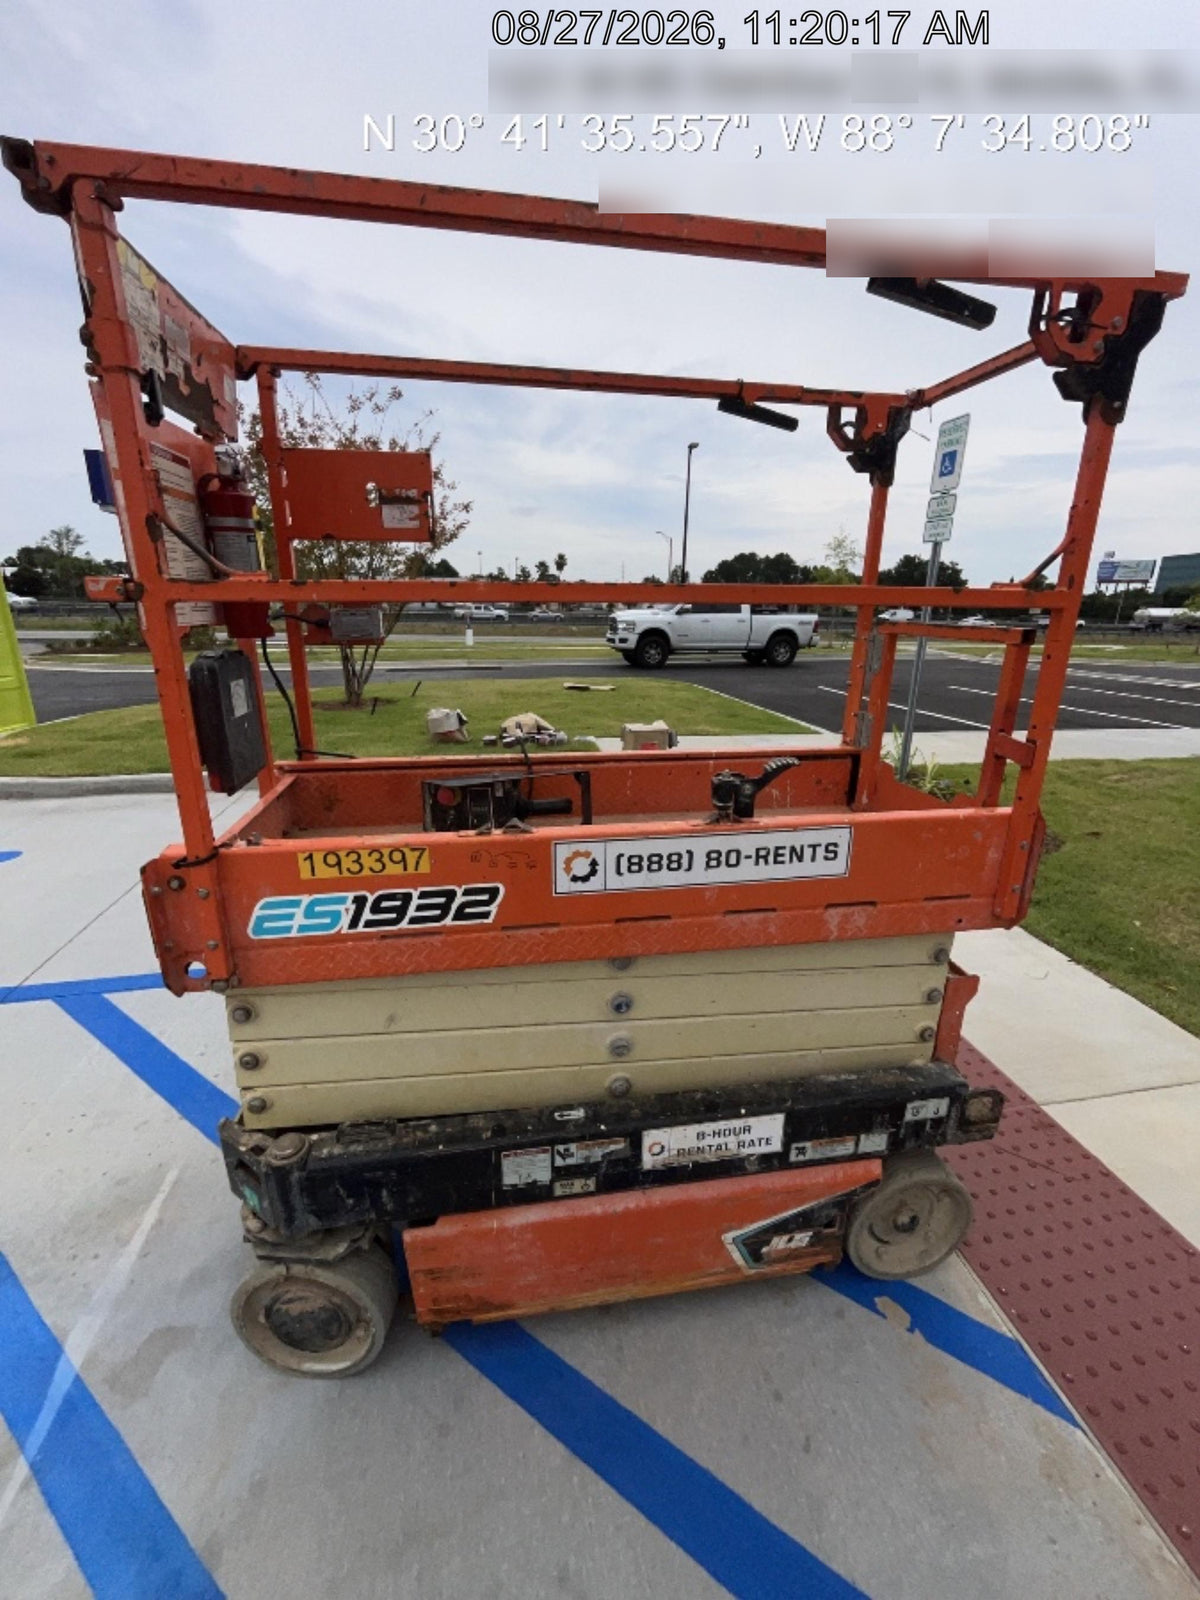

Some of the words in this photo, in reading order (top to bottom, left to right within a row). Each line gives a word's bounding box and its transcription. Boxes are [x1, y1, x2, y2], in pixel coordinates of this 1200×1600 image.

[303, 847, 428, 878] 193397
[614, 849, 694, 877] (888)
[704, 842, 840, 871] 80-RENTS
[250, 884, 503, 939] ES1932
[677, 1143, 730, 1157] RENTAL
[737, 1137, 773, 1150] RATE
